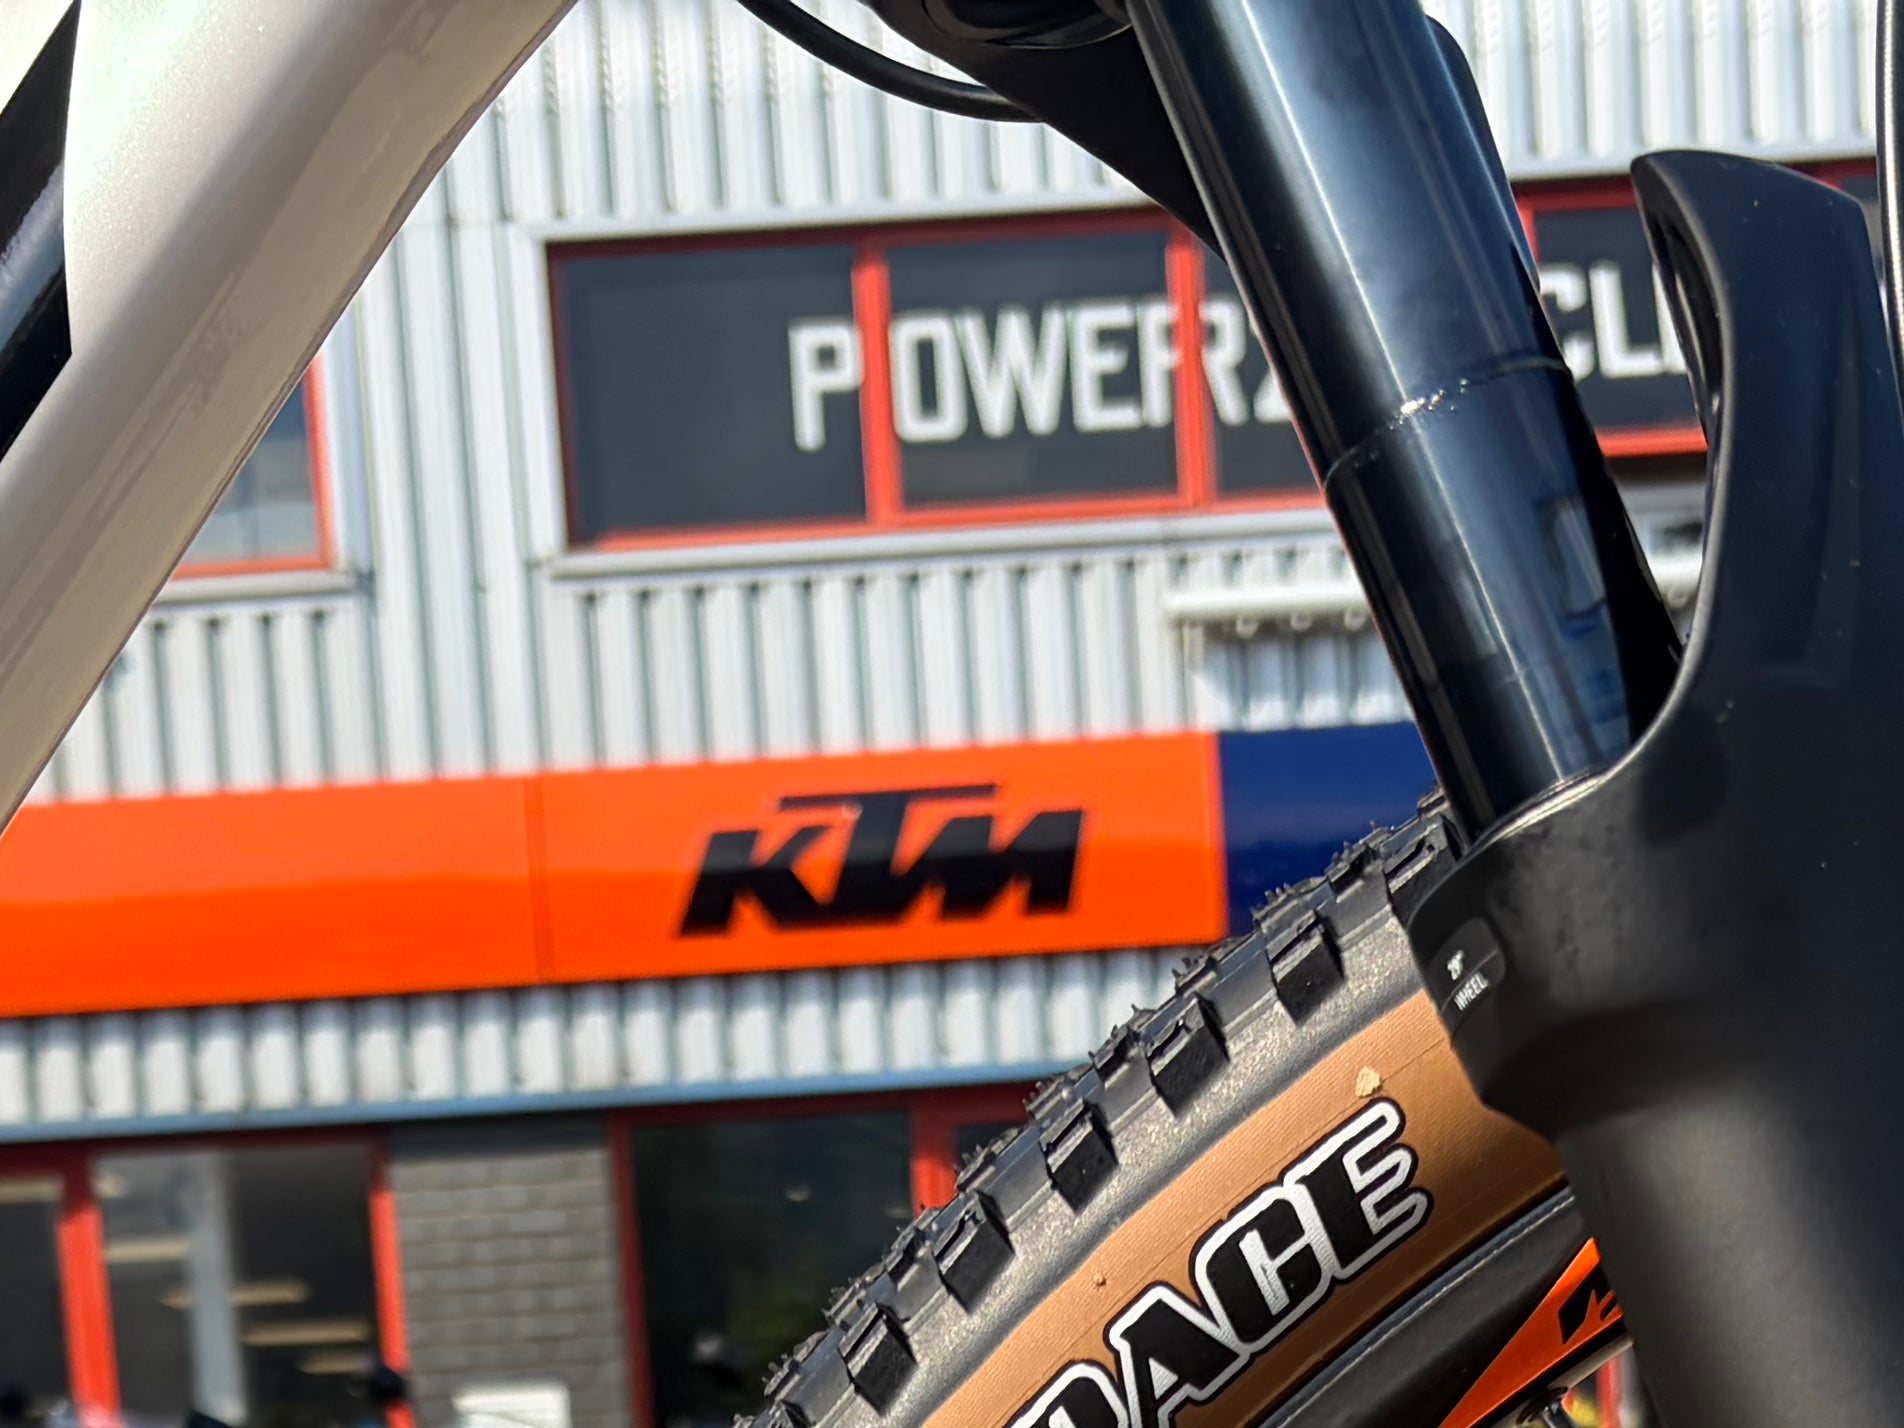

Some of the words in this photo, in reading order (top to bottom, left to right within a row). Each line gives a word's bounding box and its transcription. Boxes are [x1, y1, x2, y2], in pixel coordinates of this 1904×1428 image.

[788, 292, 1292, 451] POWER
[677, 781, 1084, 938] KTM
[1454, 972, 1489, 1011] WHEEL
